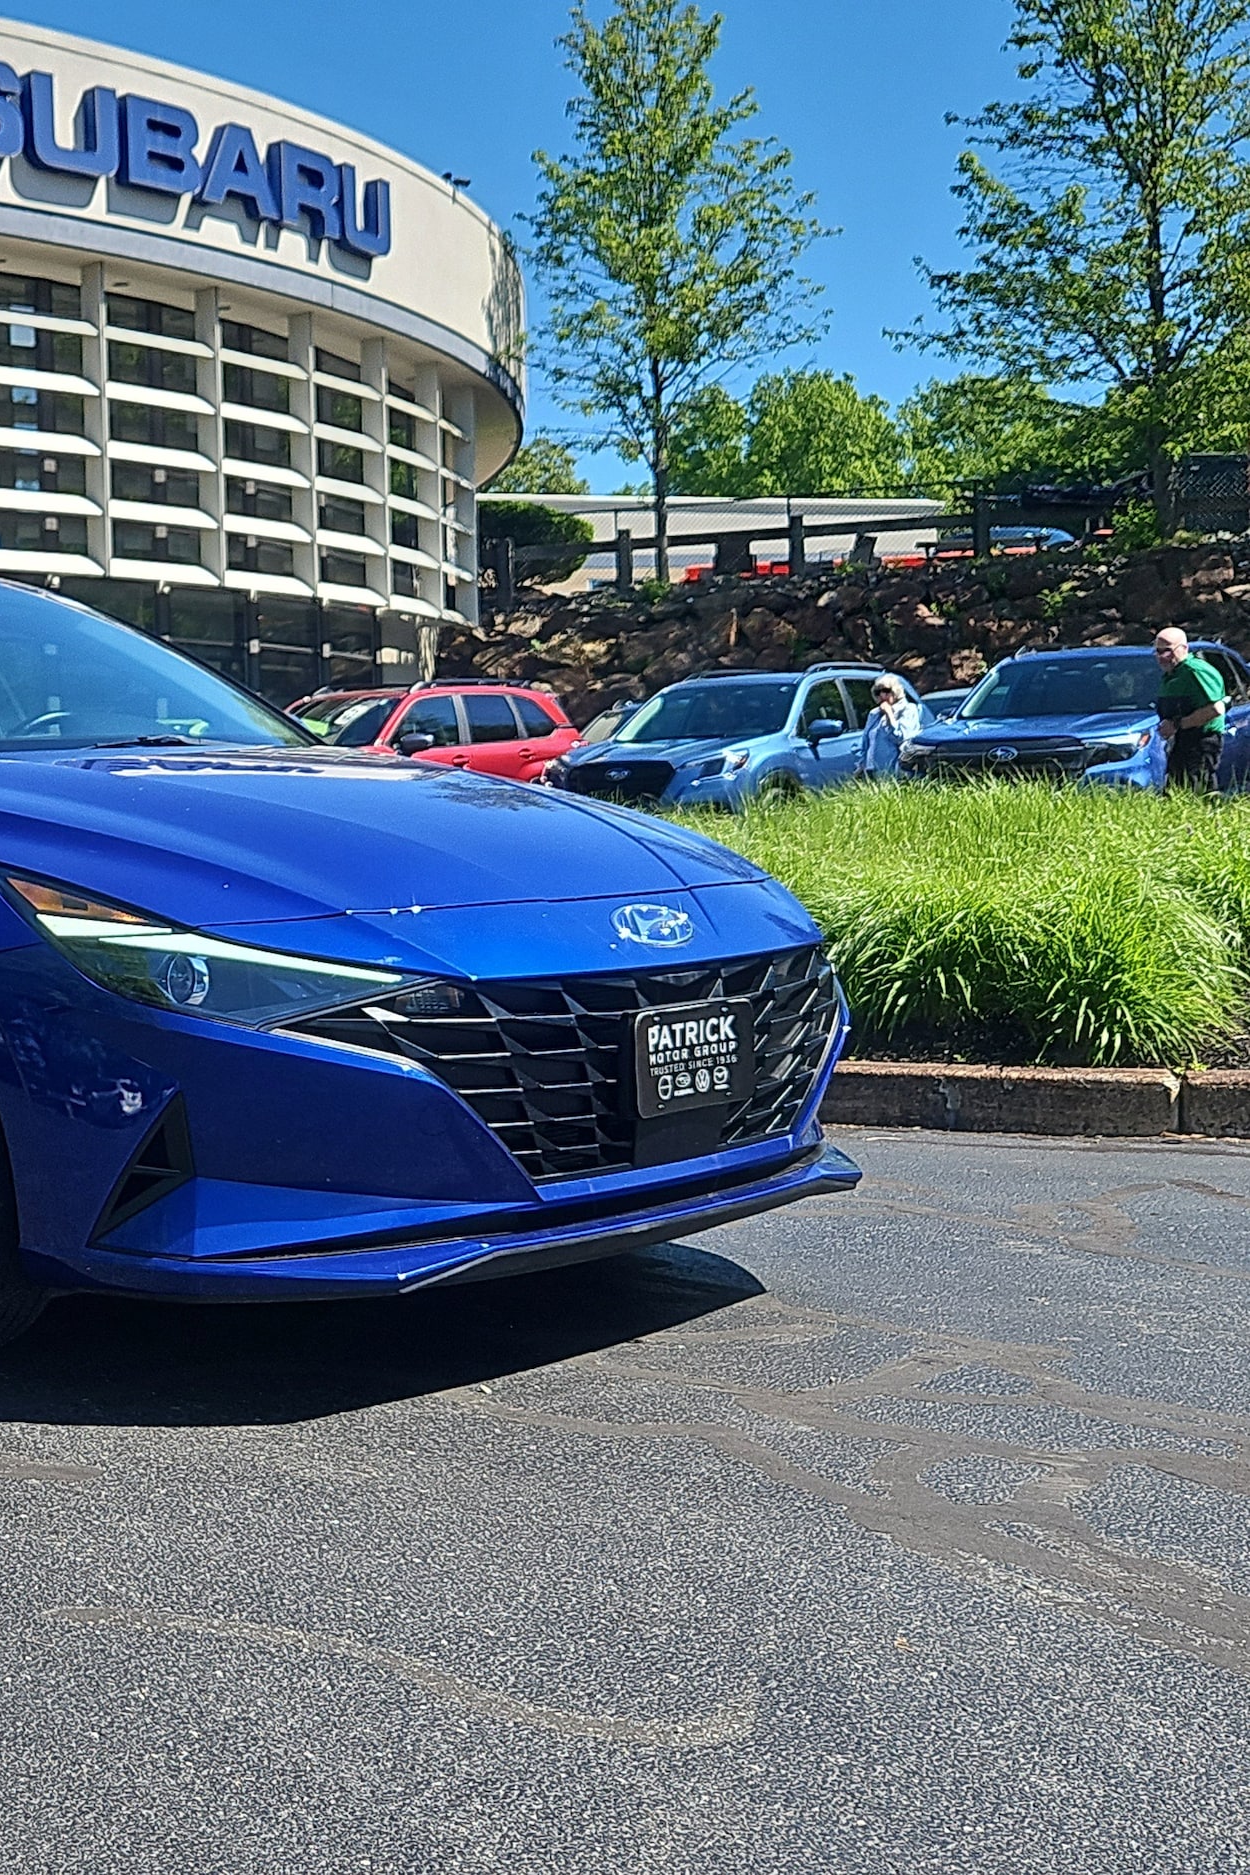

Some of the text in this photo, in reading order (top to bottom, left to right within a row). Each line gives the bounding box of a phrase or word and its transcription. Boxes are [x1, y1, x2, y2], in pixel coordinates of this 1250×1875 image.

[648, 1015, 736, 1052] PATRICK
[649, 1041, 737, 1066] MOTOR GROUP
[650, 1062, 685, 1076] TRUSTED
[687, 1057, 714, 1069] SINCE
